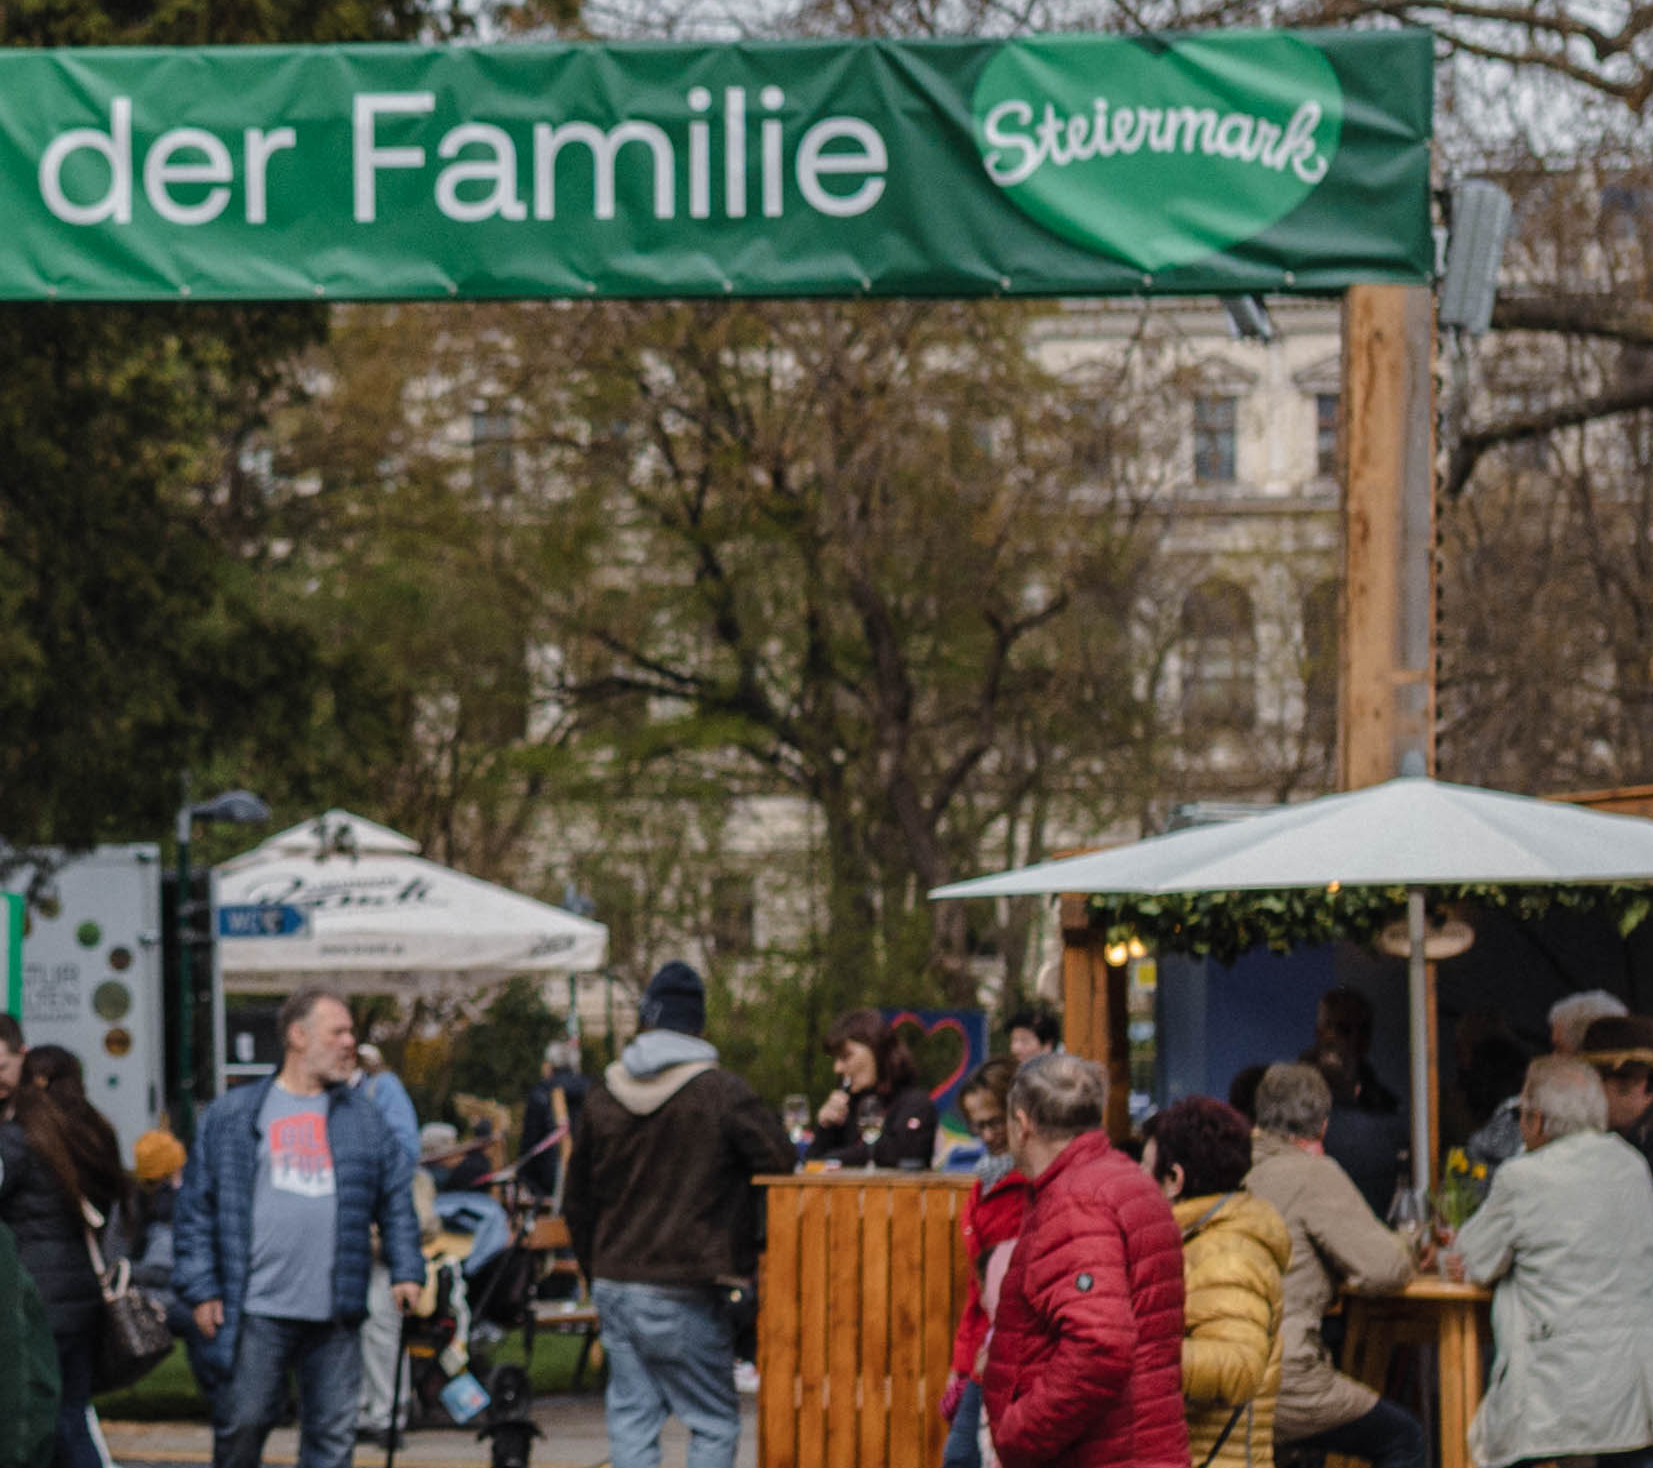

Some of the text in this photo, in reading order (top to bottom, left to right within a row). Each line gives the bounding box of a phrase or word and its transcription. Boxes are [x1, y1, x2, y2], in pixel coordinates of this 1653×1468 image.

[38, 95, 296, 227] der
[353, 84, 889, 224] Familie
[983, 96, 1329, 187] Steiermark
